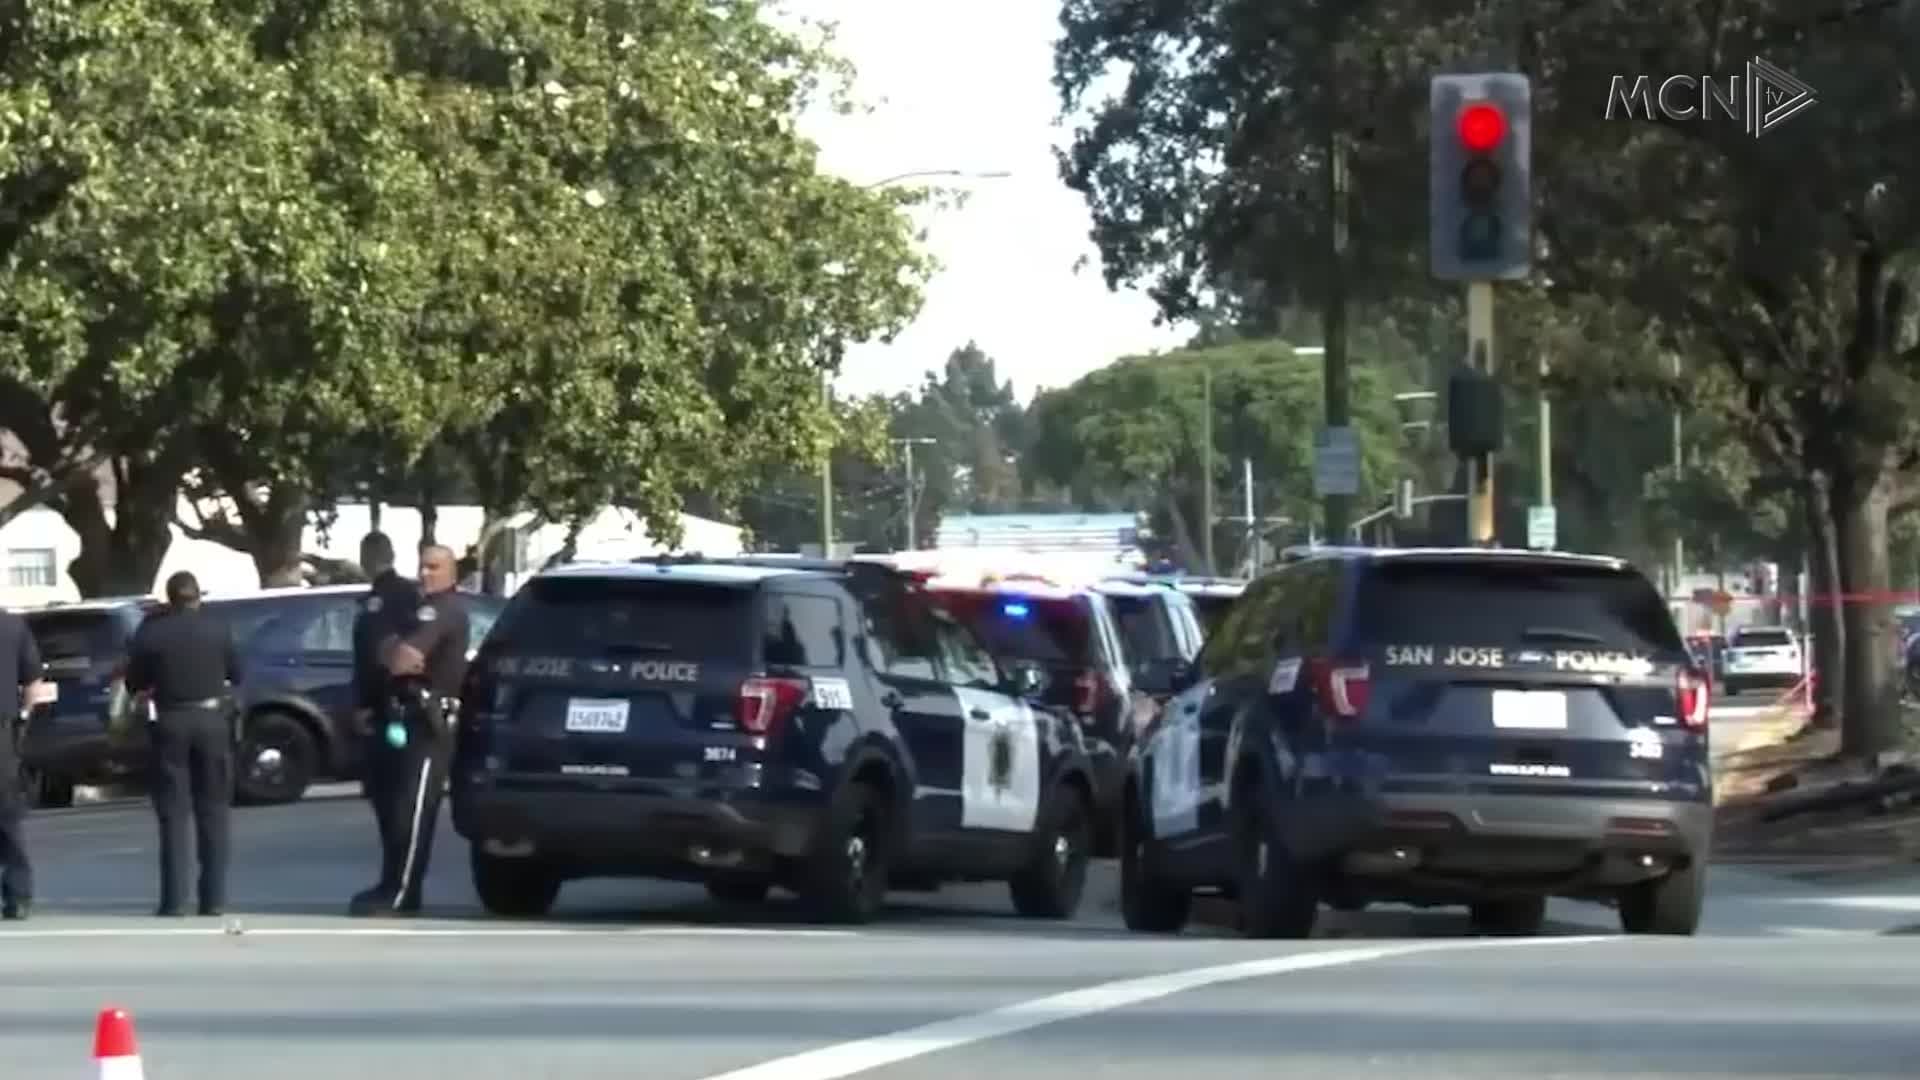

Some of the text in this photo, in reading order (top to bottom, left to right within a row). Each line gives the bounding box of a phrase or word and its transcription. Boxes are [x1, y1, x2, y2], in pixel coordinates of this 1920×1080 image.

[1385, 645, 1434, 666] SAN
[1444, 647, 1504, 668] JOSE
[630, 659, 700, 682] POLICE
